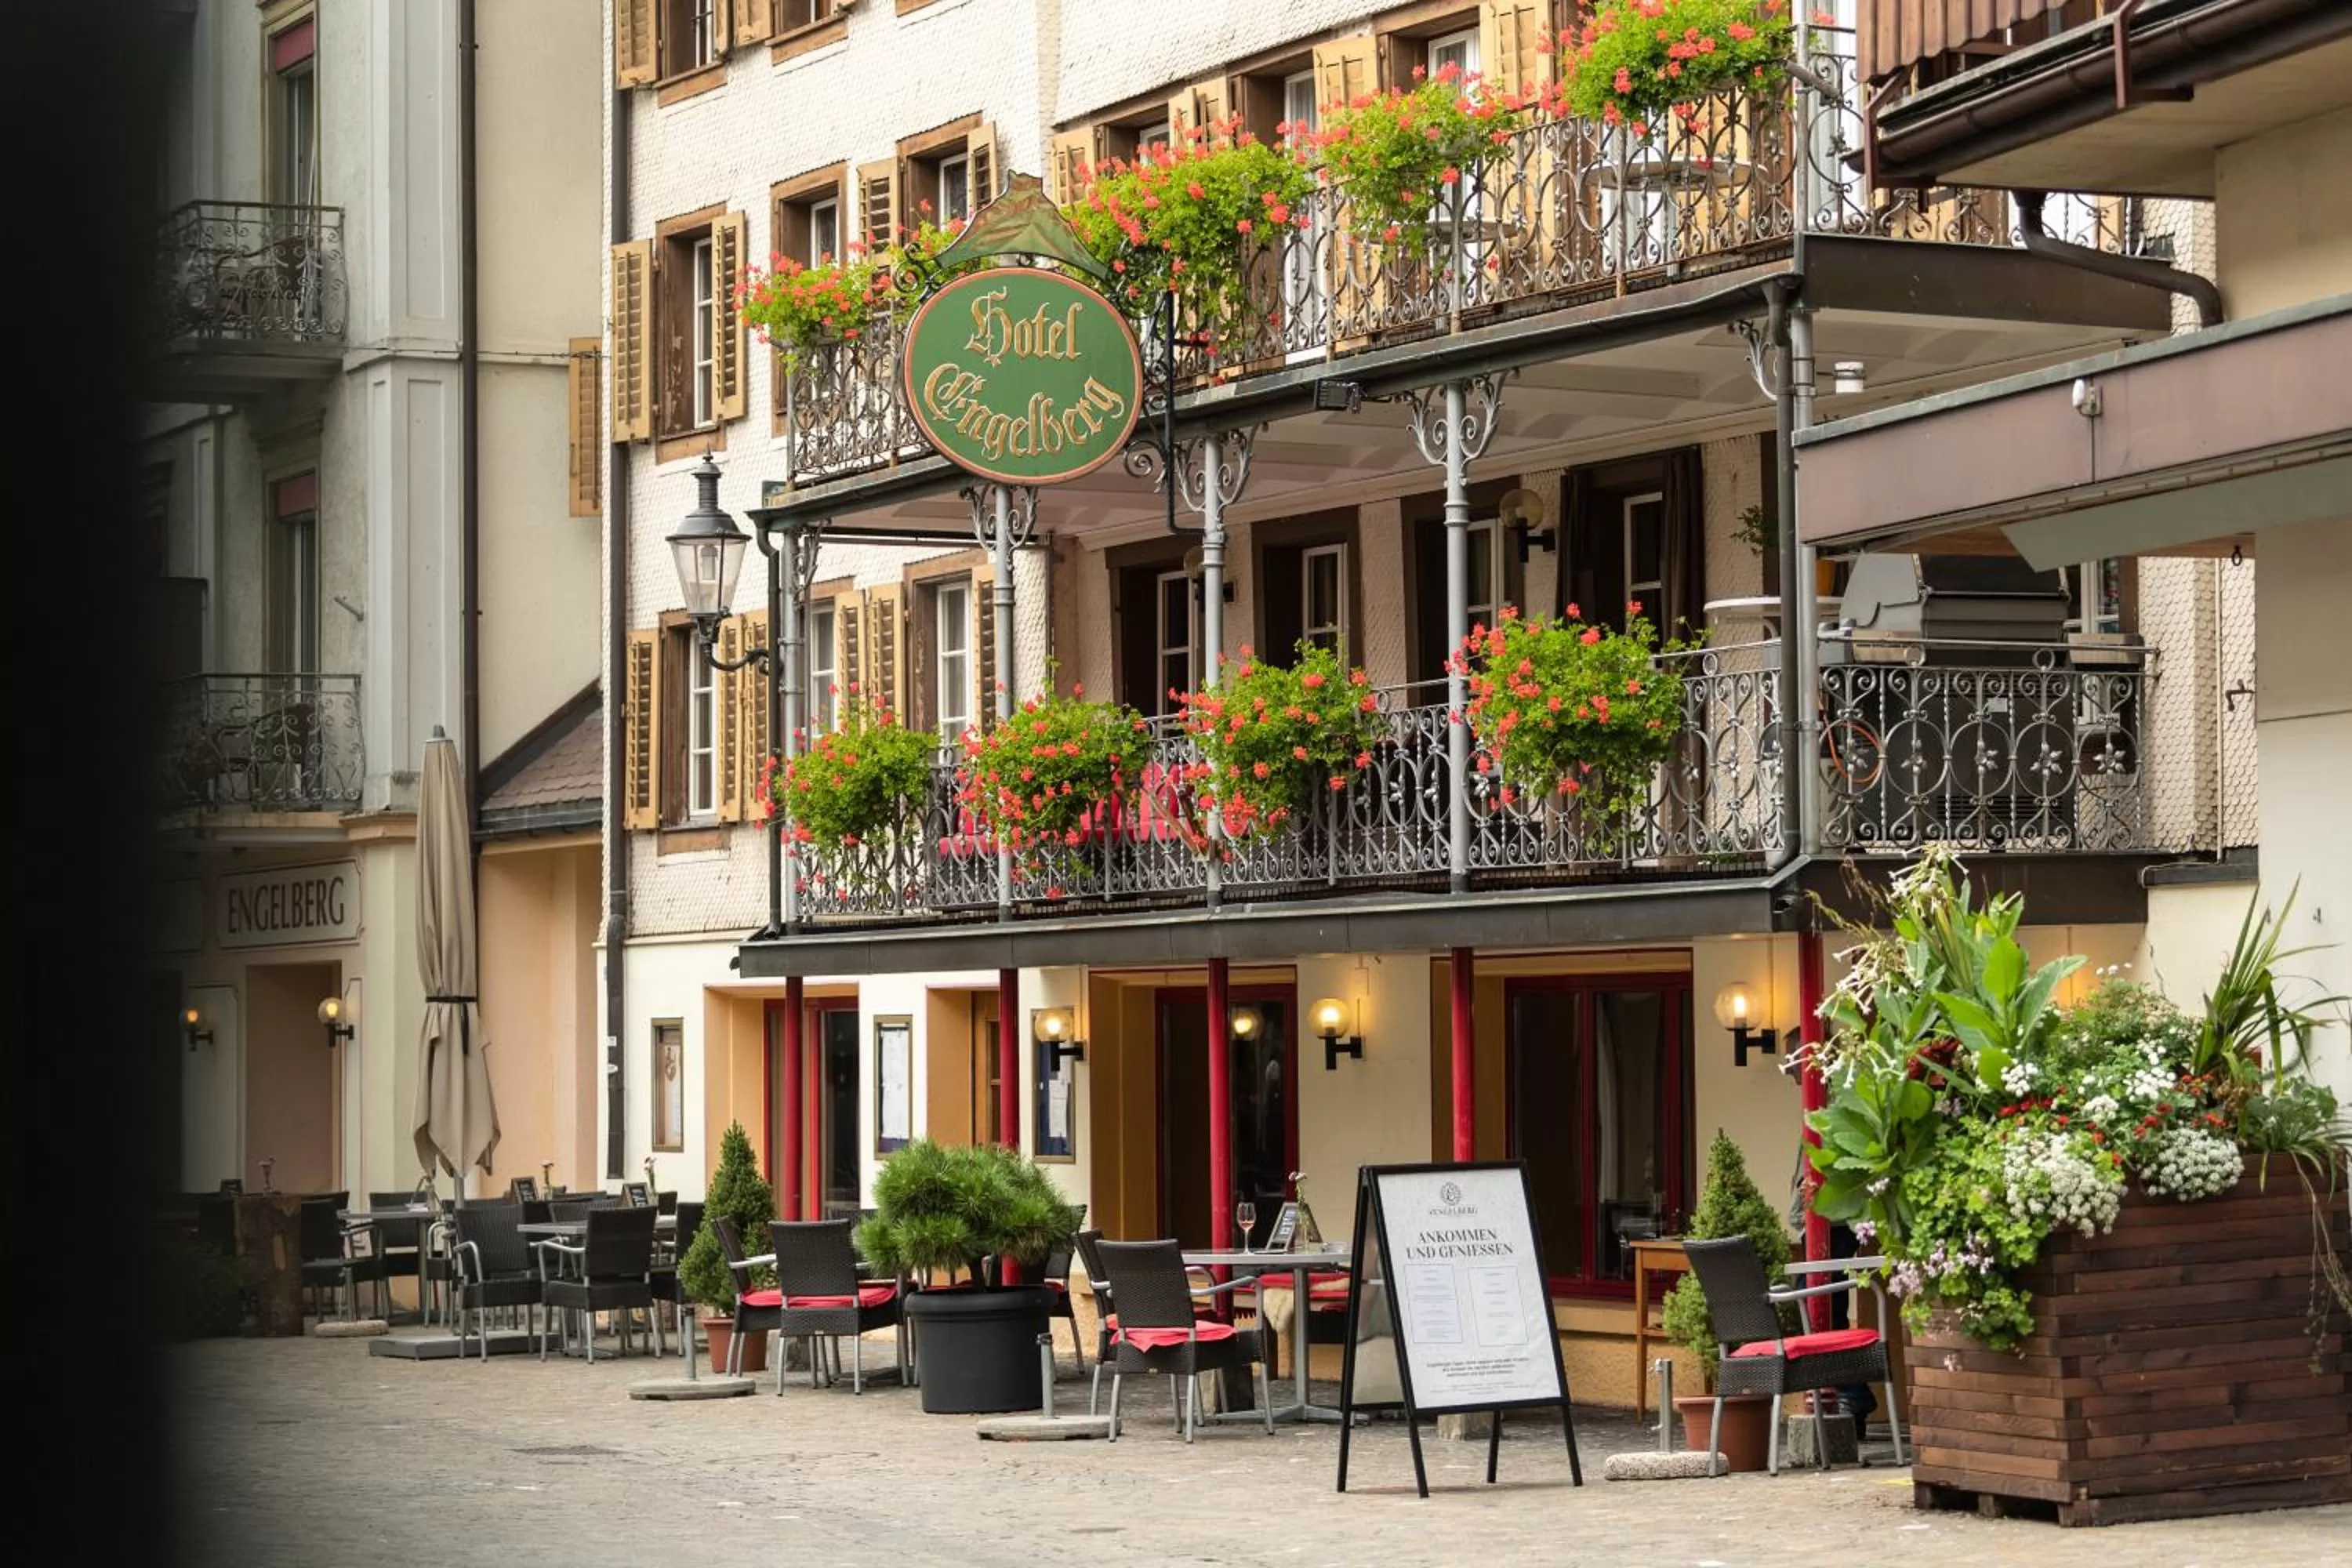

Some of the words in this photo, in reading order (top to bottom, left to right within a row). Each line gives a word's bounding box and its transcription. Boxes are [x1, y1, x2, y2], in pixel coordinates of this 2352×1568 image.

[964, 286, 1084, 367] Hotel
[924, 363, 1124, 462] Engelberg
[227, 877, 345, 934] ENGELBERG
[1406, 1245, 1436, 1259] UND
[1439, 1243, 1515, 1258] GENIESSEN
[1419, 1229, 1497, 1244] ANKOMMEN
